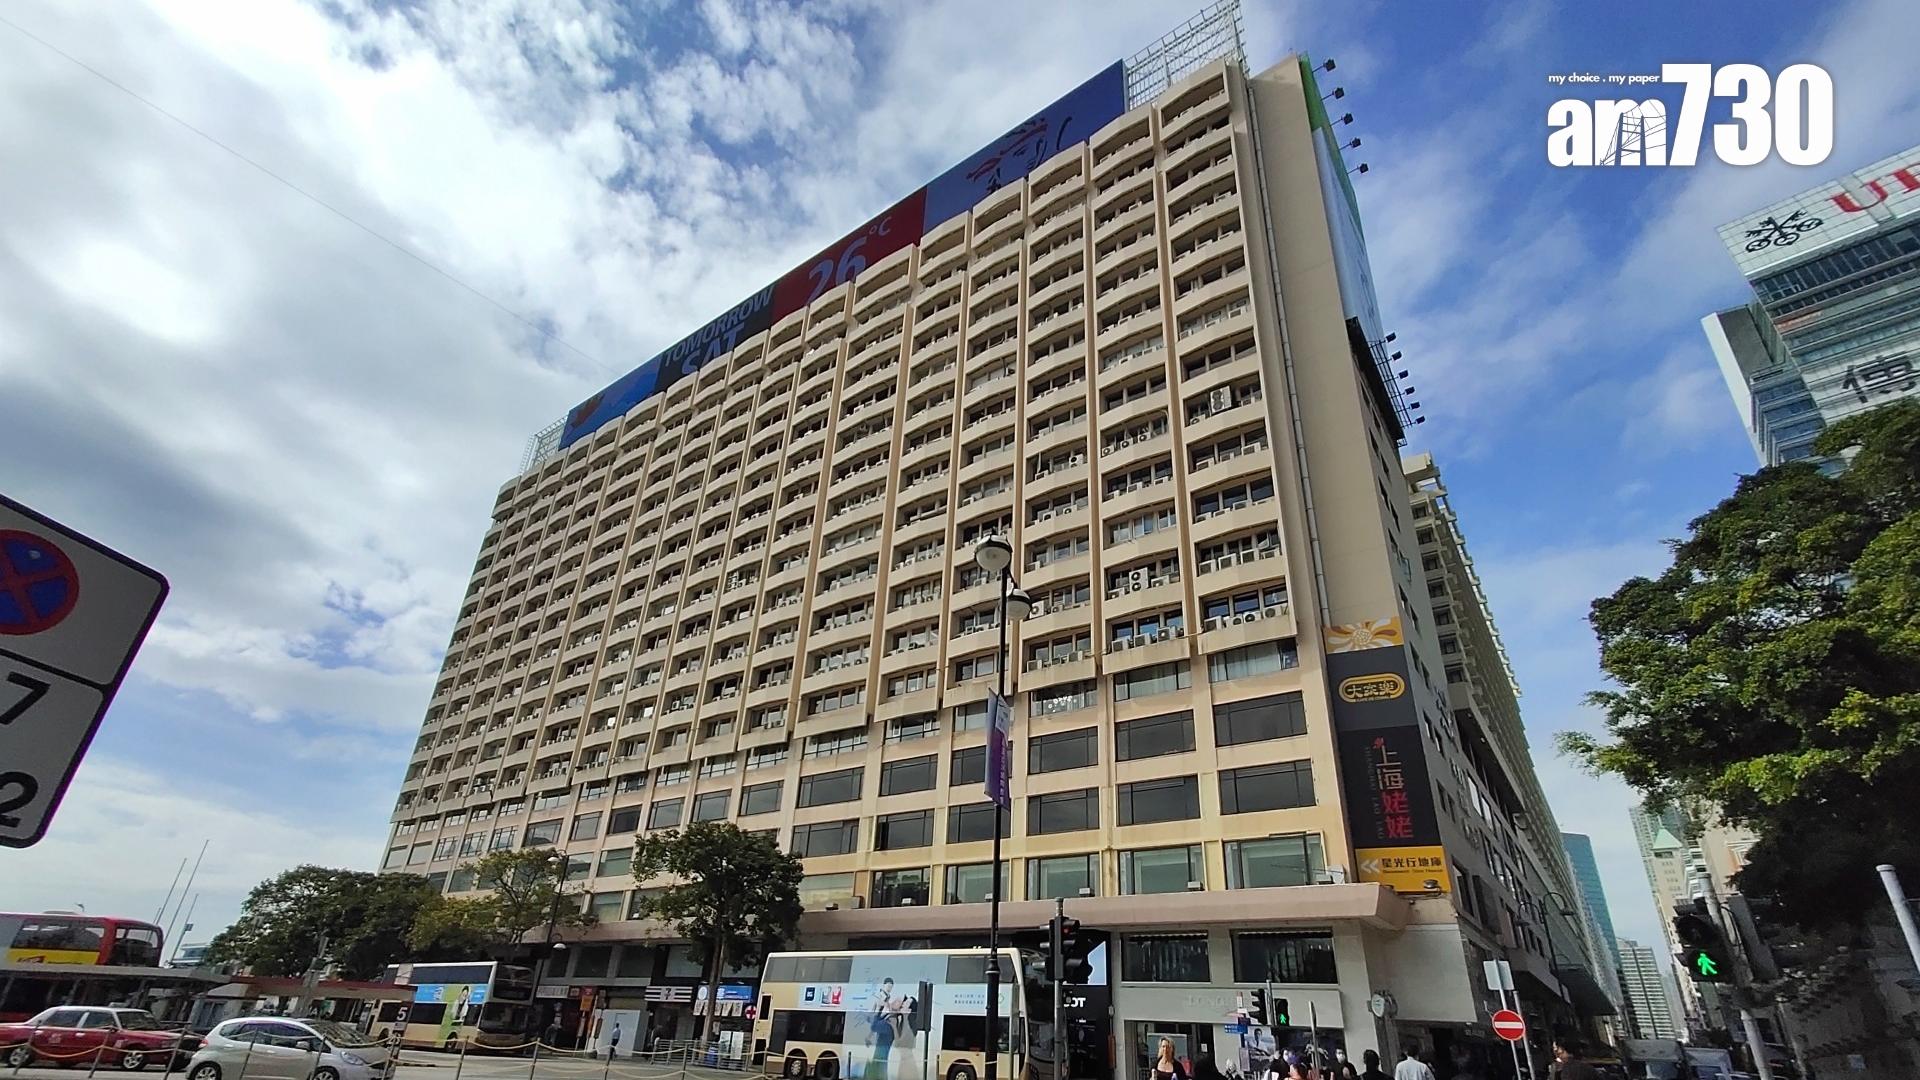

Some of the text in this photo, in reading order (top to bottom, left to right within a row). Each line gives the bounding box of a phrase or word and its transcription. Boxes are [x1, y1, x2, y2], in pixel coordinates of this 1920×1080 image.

[806, 236, 867, 307] 26
[665, 285, 775, 367] TOMORROW
[681, 323, 744, 376] SAT
[0, 672, 50, 725] 7
[0, 772, 38, 828] 2
[1375, 744, 1414, 839] 上海姥姥
[396, 1007, 408, 1021] 5
